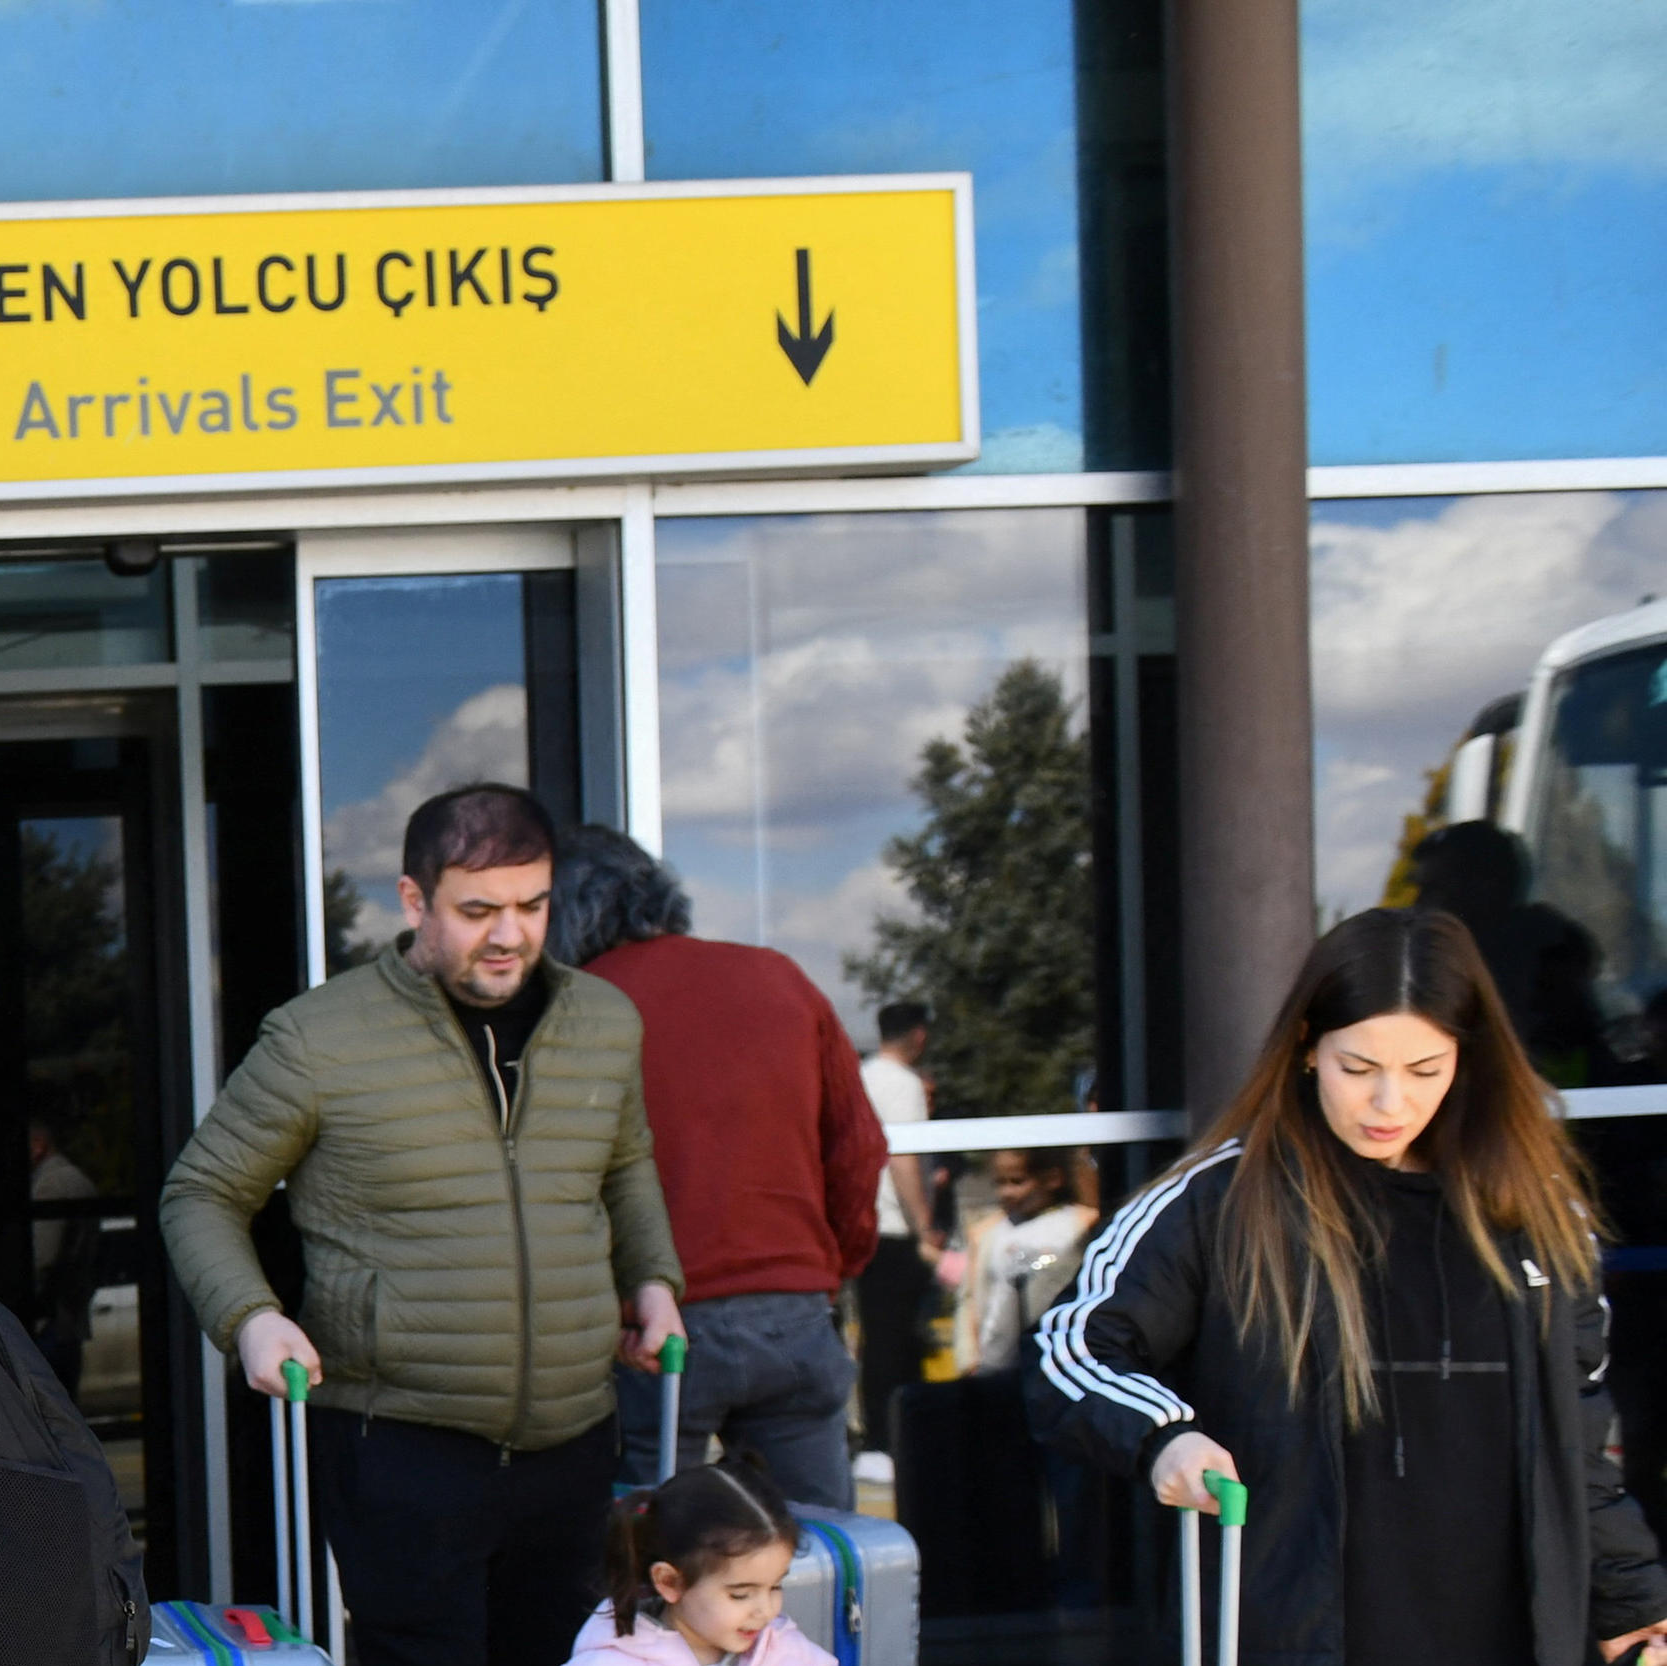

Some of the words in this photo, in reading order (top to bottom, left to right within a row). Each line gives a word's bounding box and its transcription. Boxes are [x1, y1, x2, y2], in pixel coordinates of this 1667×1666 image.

[111, 252, 348, 318] YOLCU
[375, 245, 560, 318] ÇIKIŞ
[13, 372, 299, 441] Arrivals
[324, 366, 454, 428] Exit
